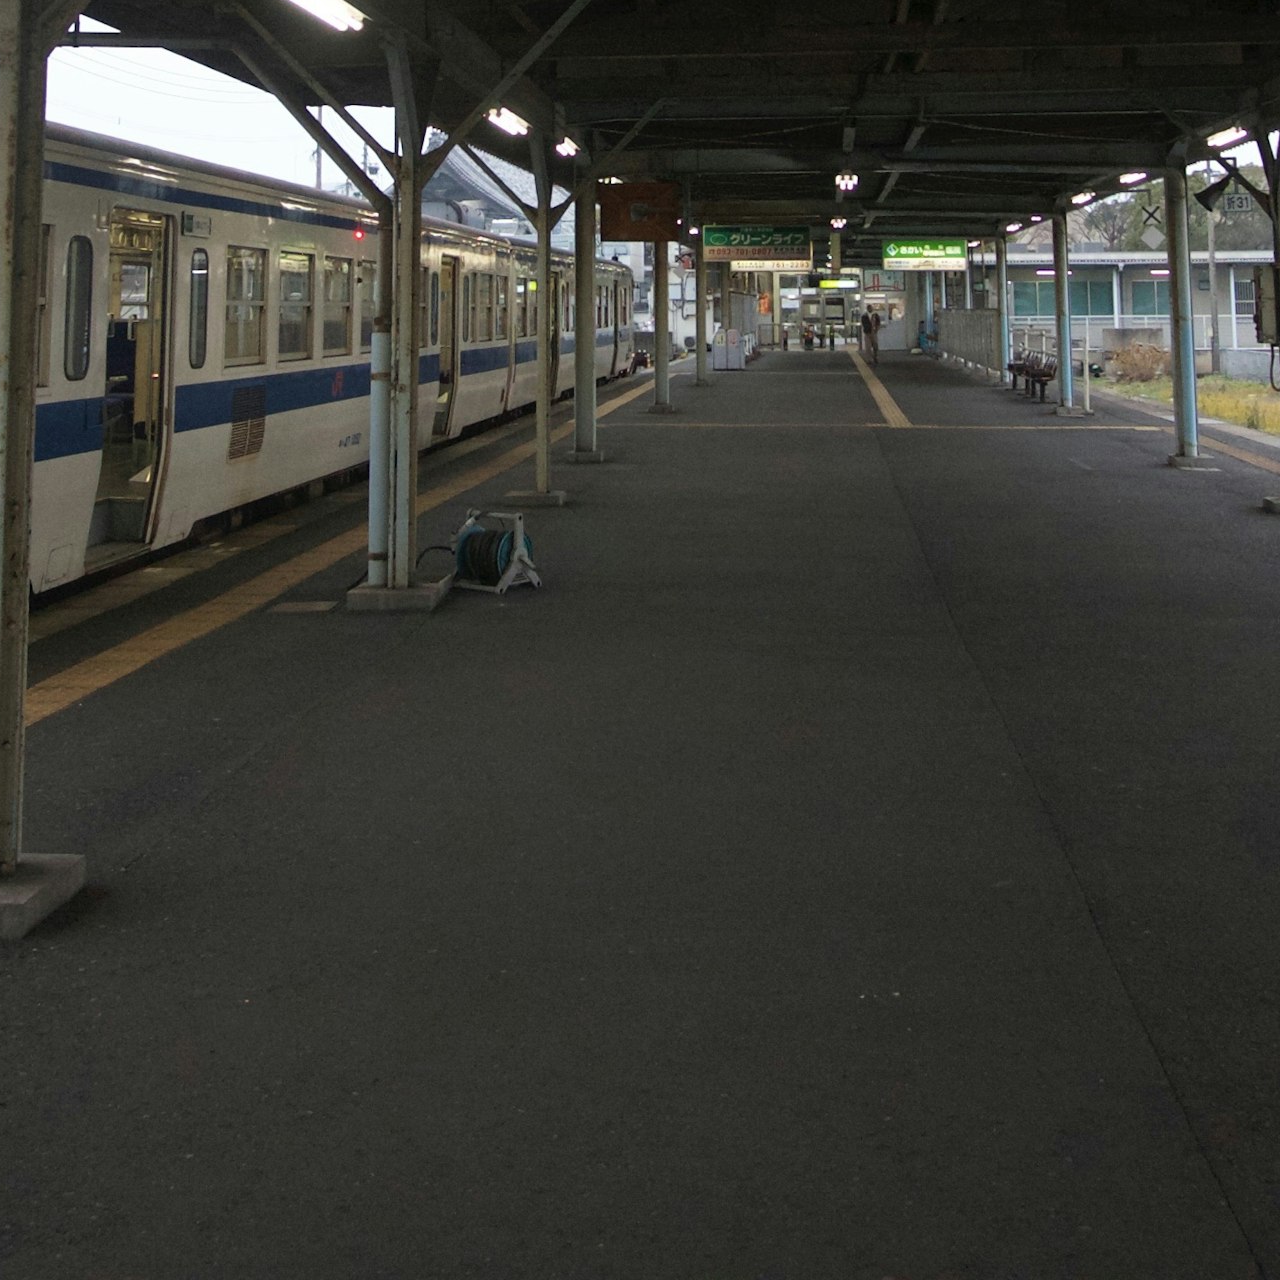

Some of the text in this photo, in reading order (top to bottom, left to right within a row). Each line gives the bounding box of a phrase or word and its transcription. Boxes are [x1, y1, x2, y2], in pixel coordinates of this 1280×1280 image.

[730, 233, 804, 245] グリーンライフ
